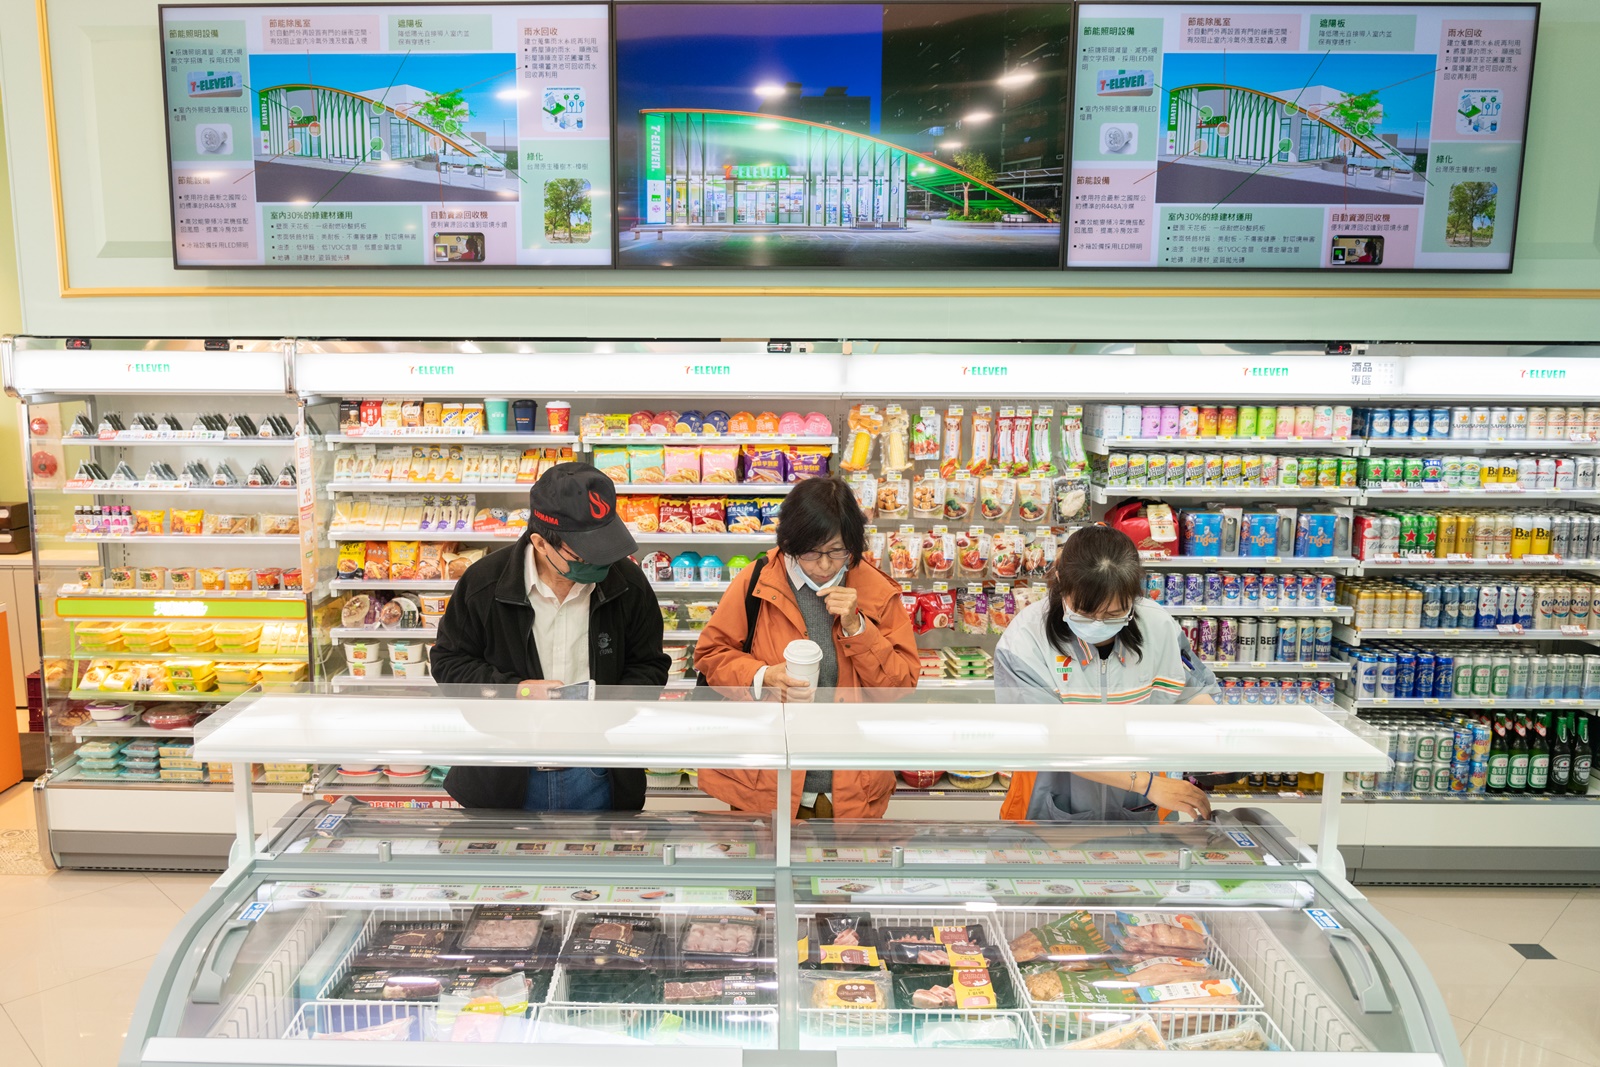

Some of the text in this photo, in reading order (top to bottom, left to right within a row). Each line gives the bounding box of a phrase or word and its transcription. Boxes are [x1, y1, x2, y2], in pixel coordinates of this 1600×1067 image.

[269, 18, 311, 28] 節能除風室
[1188, 17, 1231, 26] 節能除風室
[169, 29, 219, 38] 節能照明設備
[524, 27, 558, 36] 雨水回收
[1083, 26, 1135, 36] 節能照明設備
[1447, 28, 1482, 38] 雨水回收
[171, 65, 178, 73] 明
[1082, 63, 1089, 71] 明
[527, 152, 543, 161] 綠化
[1436, 155, 1453, 164] 綠化
[430, 211, 488, 220] 自動資源回收機
[1331, 213, 1391, 222] 自動資源回收機
[125, 363, 171, 373] 7-ELEVEN
[408, 365, 454, 375] 7-ELEVEN
[684, 365, 730, 375] 7-ELEVEN
[961, 366, 1008, 376] 7-ELEVEN
[1351, 361, 1373, 372] 酒品
[1242, 366, 1289, 377] 7-ELEVEN
[1519, 369, 1567, 379] 7-ELEVEN
[1351, 375, 1372, 385] 專區
[1488, 467, 1498, 475] Ba
[1194, 535, 1218, 547] Tiger
[1250, 535, 1274, 547] Tiger
[1308, 536, 1332, 548] Tiger
[1541, 598, 1553, 607] Ori
[1552, 598, 1570, 607] Orio
[1570, 598, 1589, 607] Orio
[368, 800, 396, 808] OPEN
